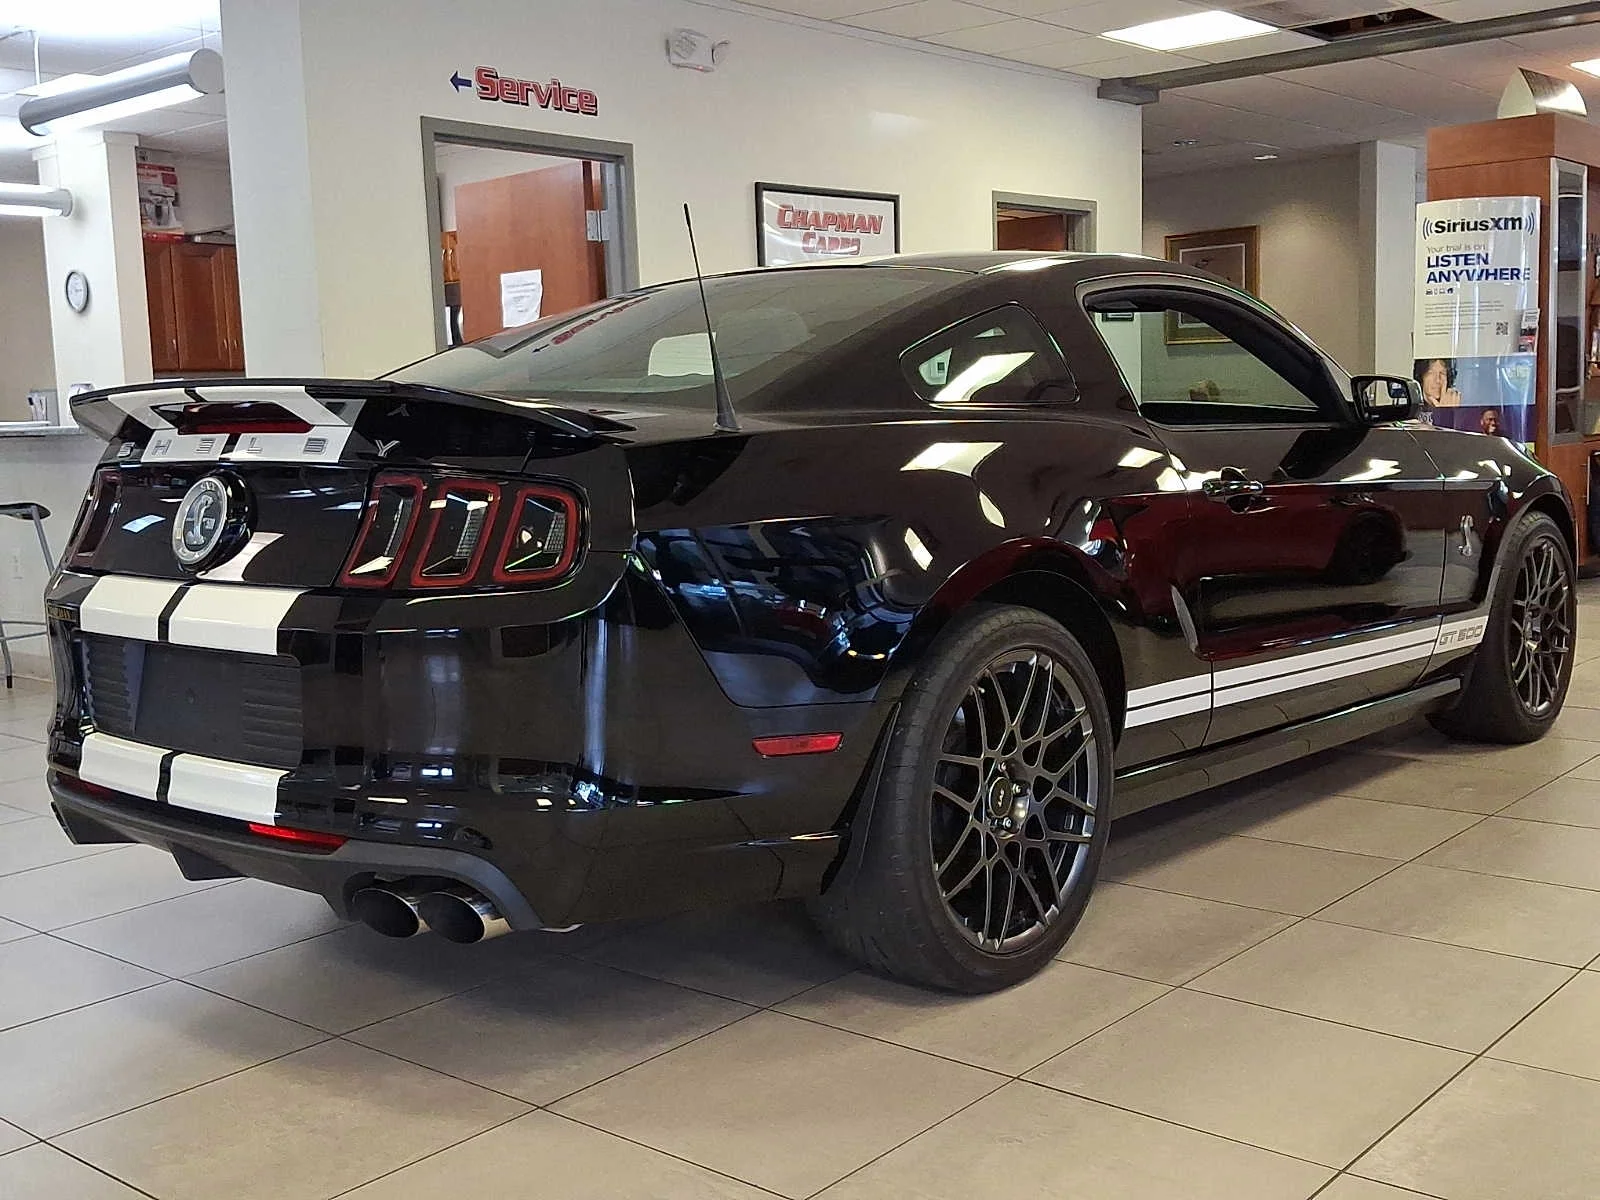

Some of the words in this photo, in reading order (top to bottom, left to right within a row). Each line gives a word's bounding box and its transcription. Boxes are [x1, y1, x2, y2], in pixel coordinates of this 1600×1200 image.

[474, 66, 598, 116] Service
[776, 204, 884, 234] CHAPMAN
[1427, 246, 1445, 254] Your
[1446, 243, 1462, 252] trial
[1427, 253, 1489, 268] LISTEN
[1427, 268, 1531, 284] ANYWHERE
